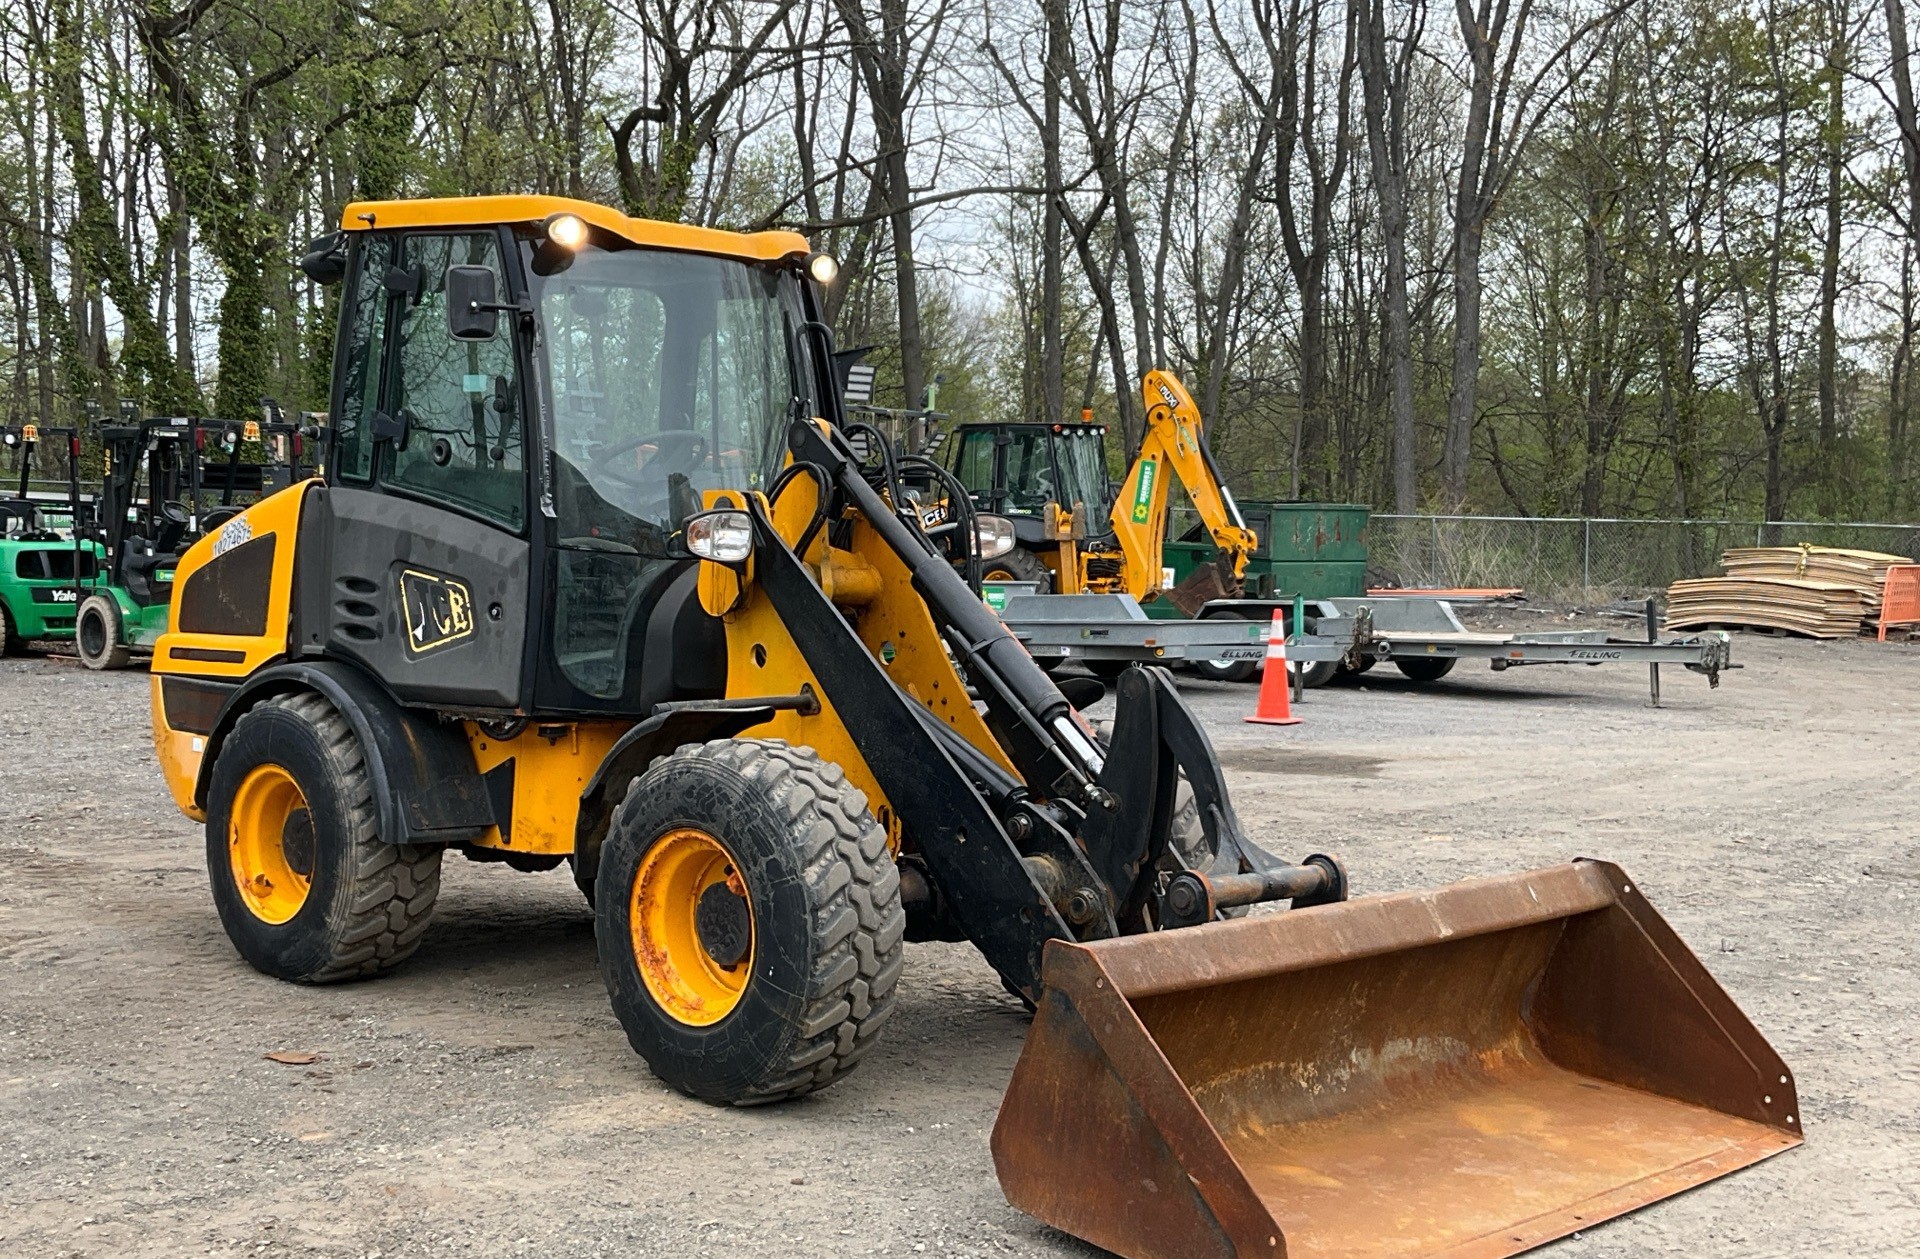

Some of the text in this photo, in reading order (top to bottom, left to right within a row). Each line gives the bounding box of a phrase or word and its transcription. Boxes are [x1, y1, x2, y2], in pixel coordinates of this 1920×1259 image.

[924, 508, 945, 526] CB
[214, 526, 252, 556] 10274675
[51, 590, 77, 602] Yale
[412, 579, 468, 641] JCB
[1218, 650, 1263, 658] ELLING
[1568, 649, 1621, 659] FELLING
